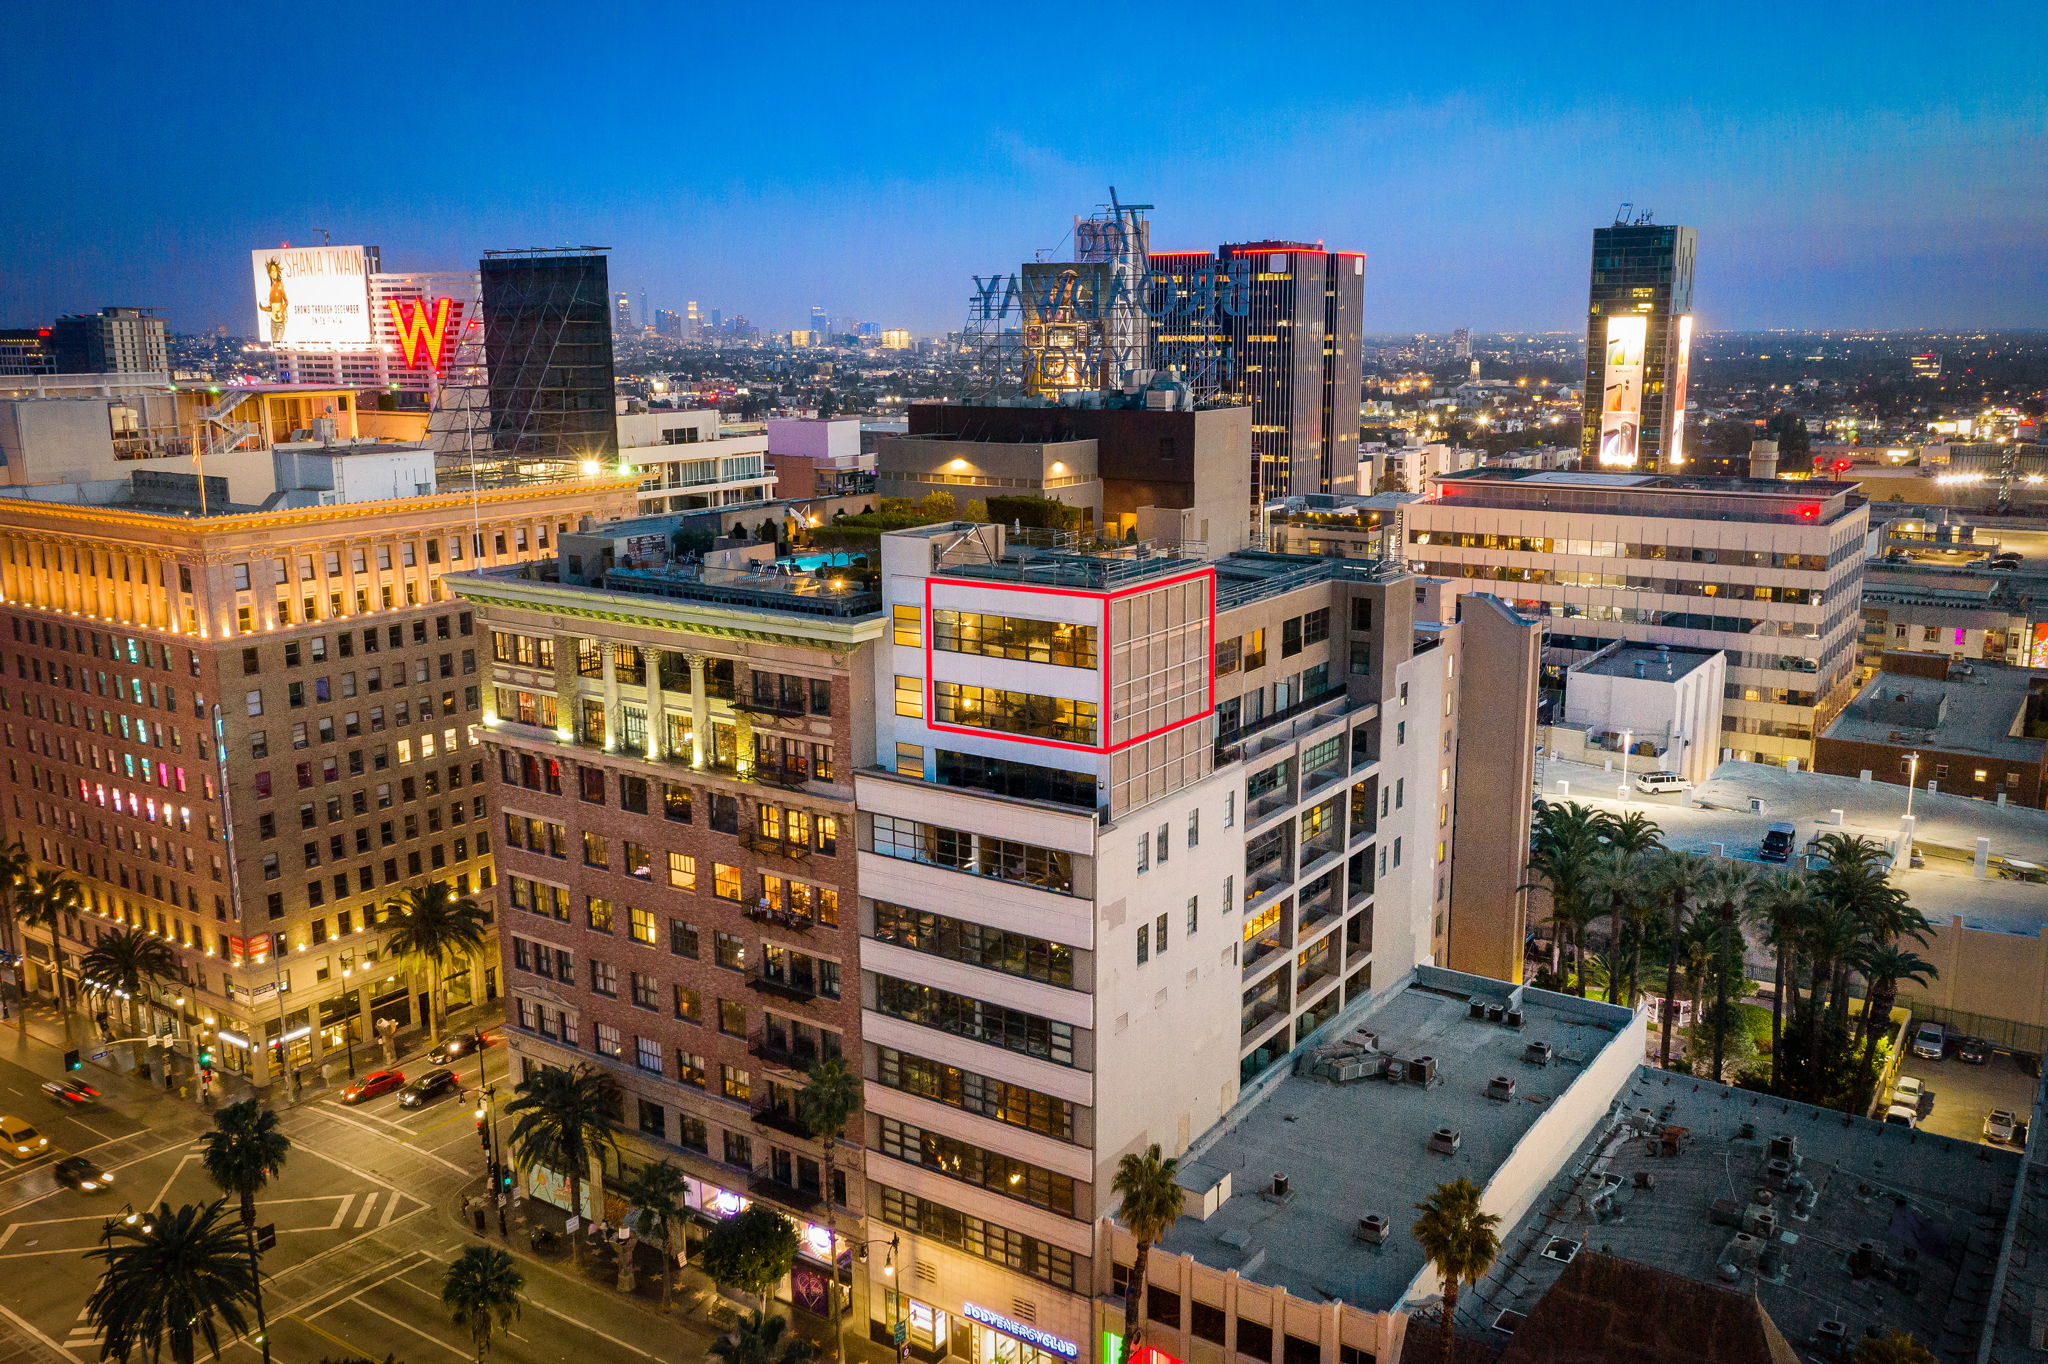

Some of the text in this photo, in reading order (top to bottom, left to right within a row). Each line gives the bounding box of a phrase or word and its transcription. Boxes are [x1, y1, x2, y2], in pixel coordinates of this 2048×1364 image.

[284, 249, 363, 278] SHANIA TWAIN
[294, 304, 359, 314] SHOWS THROUGH DECEMBER
[387, 297, 452, 369] W
